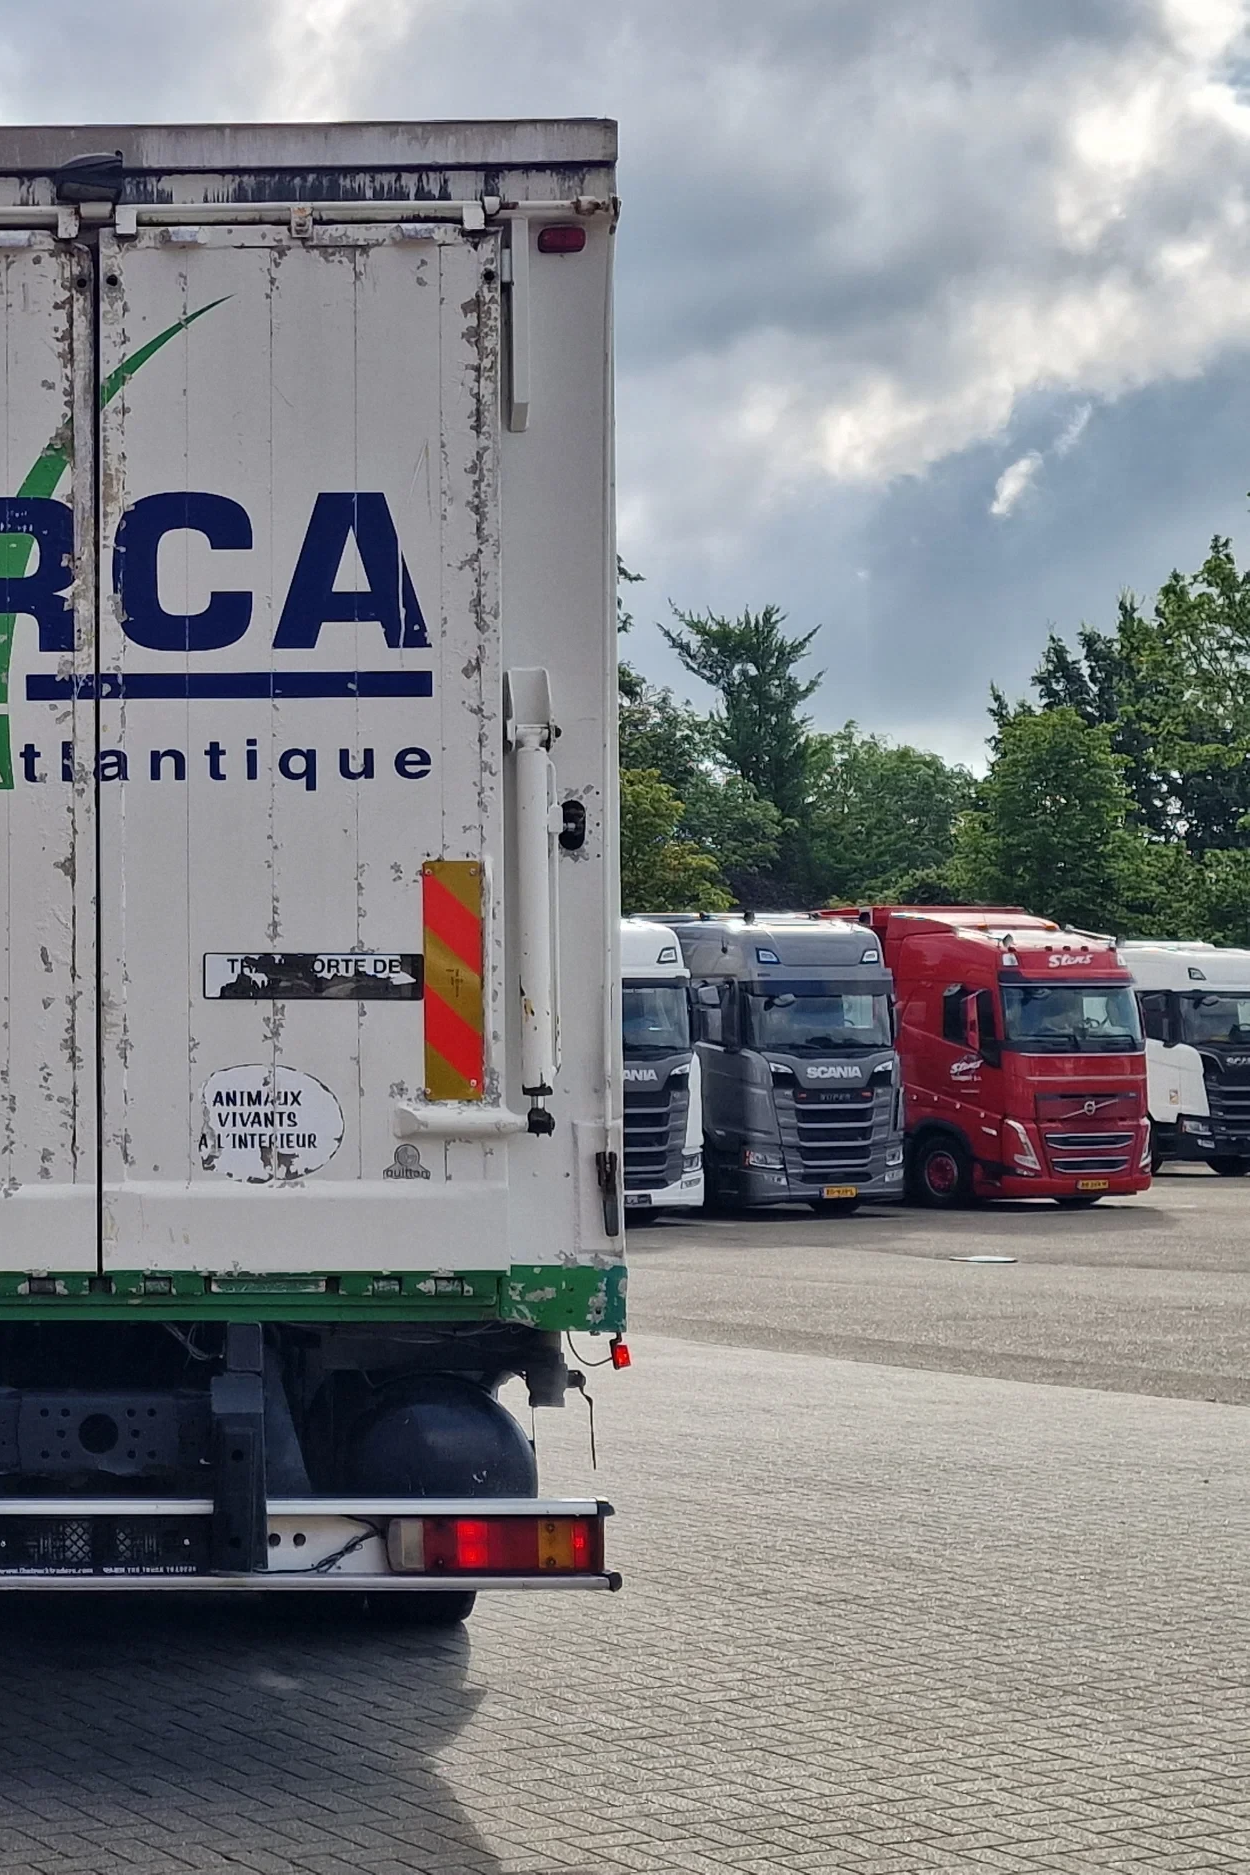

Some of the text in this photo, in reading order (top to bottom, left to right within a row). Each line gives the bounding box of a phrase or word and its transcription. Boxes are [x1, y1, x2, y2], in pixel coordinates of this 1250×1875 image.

[623, 1069, 659, 1082] ANIA
[806, 1066, 862, 1079] SCANIA
[212, 1090, 302, 1107] ANIMAUX
[217, 1111, 299, 1128] VIVANTS
